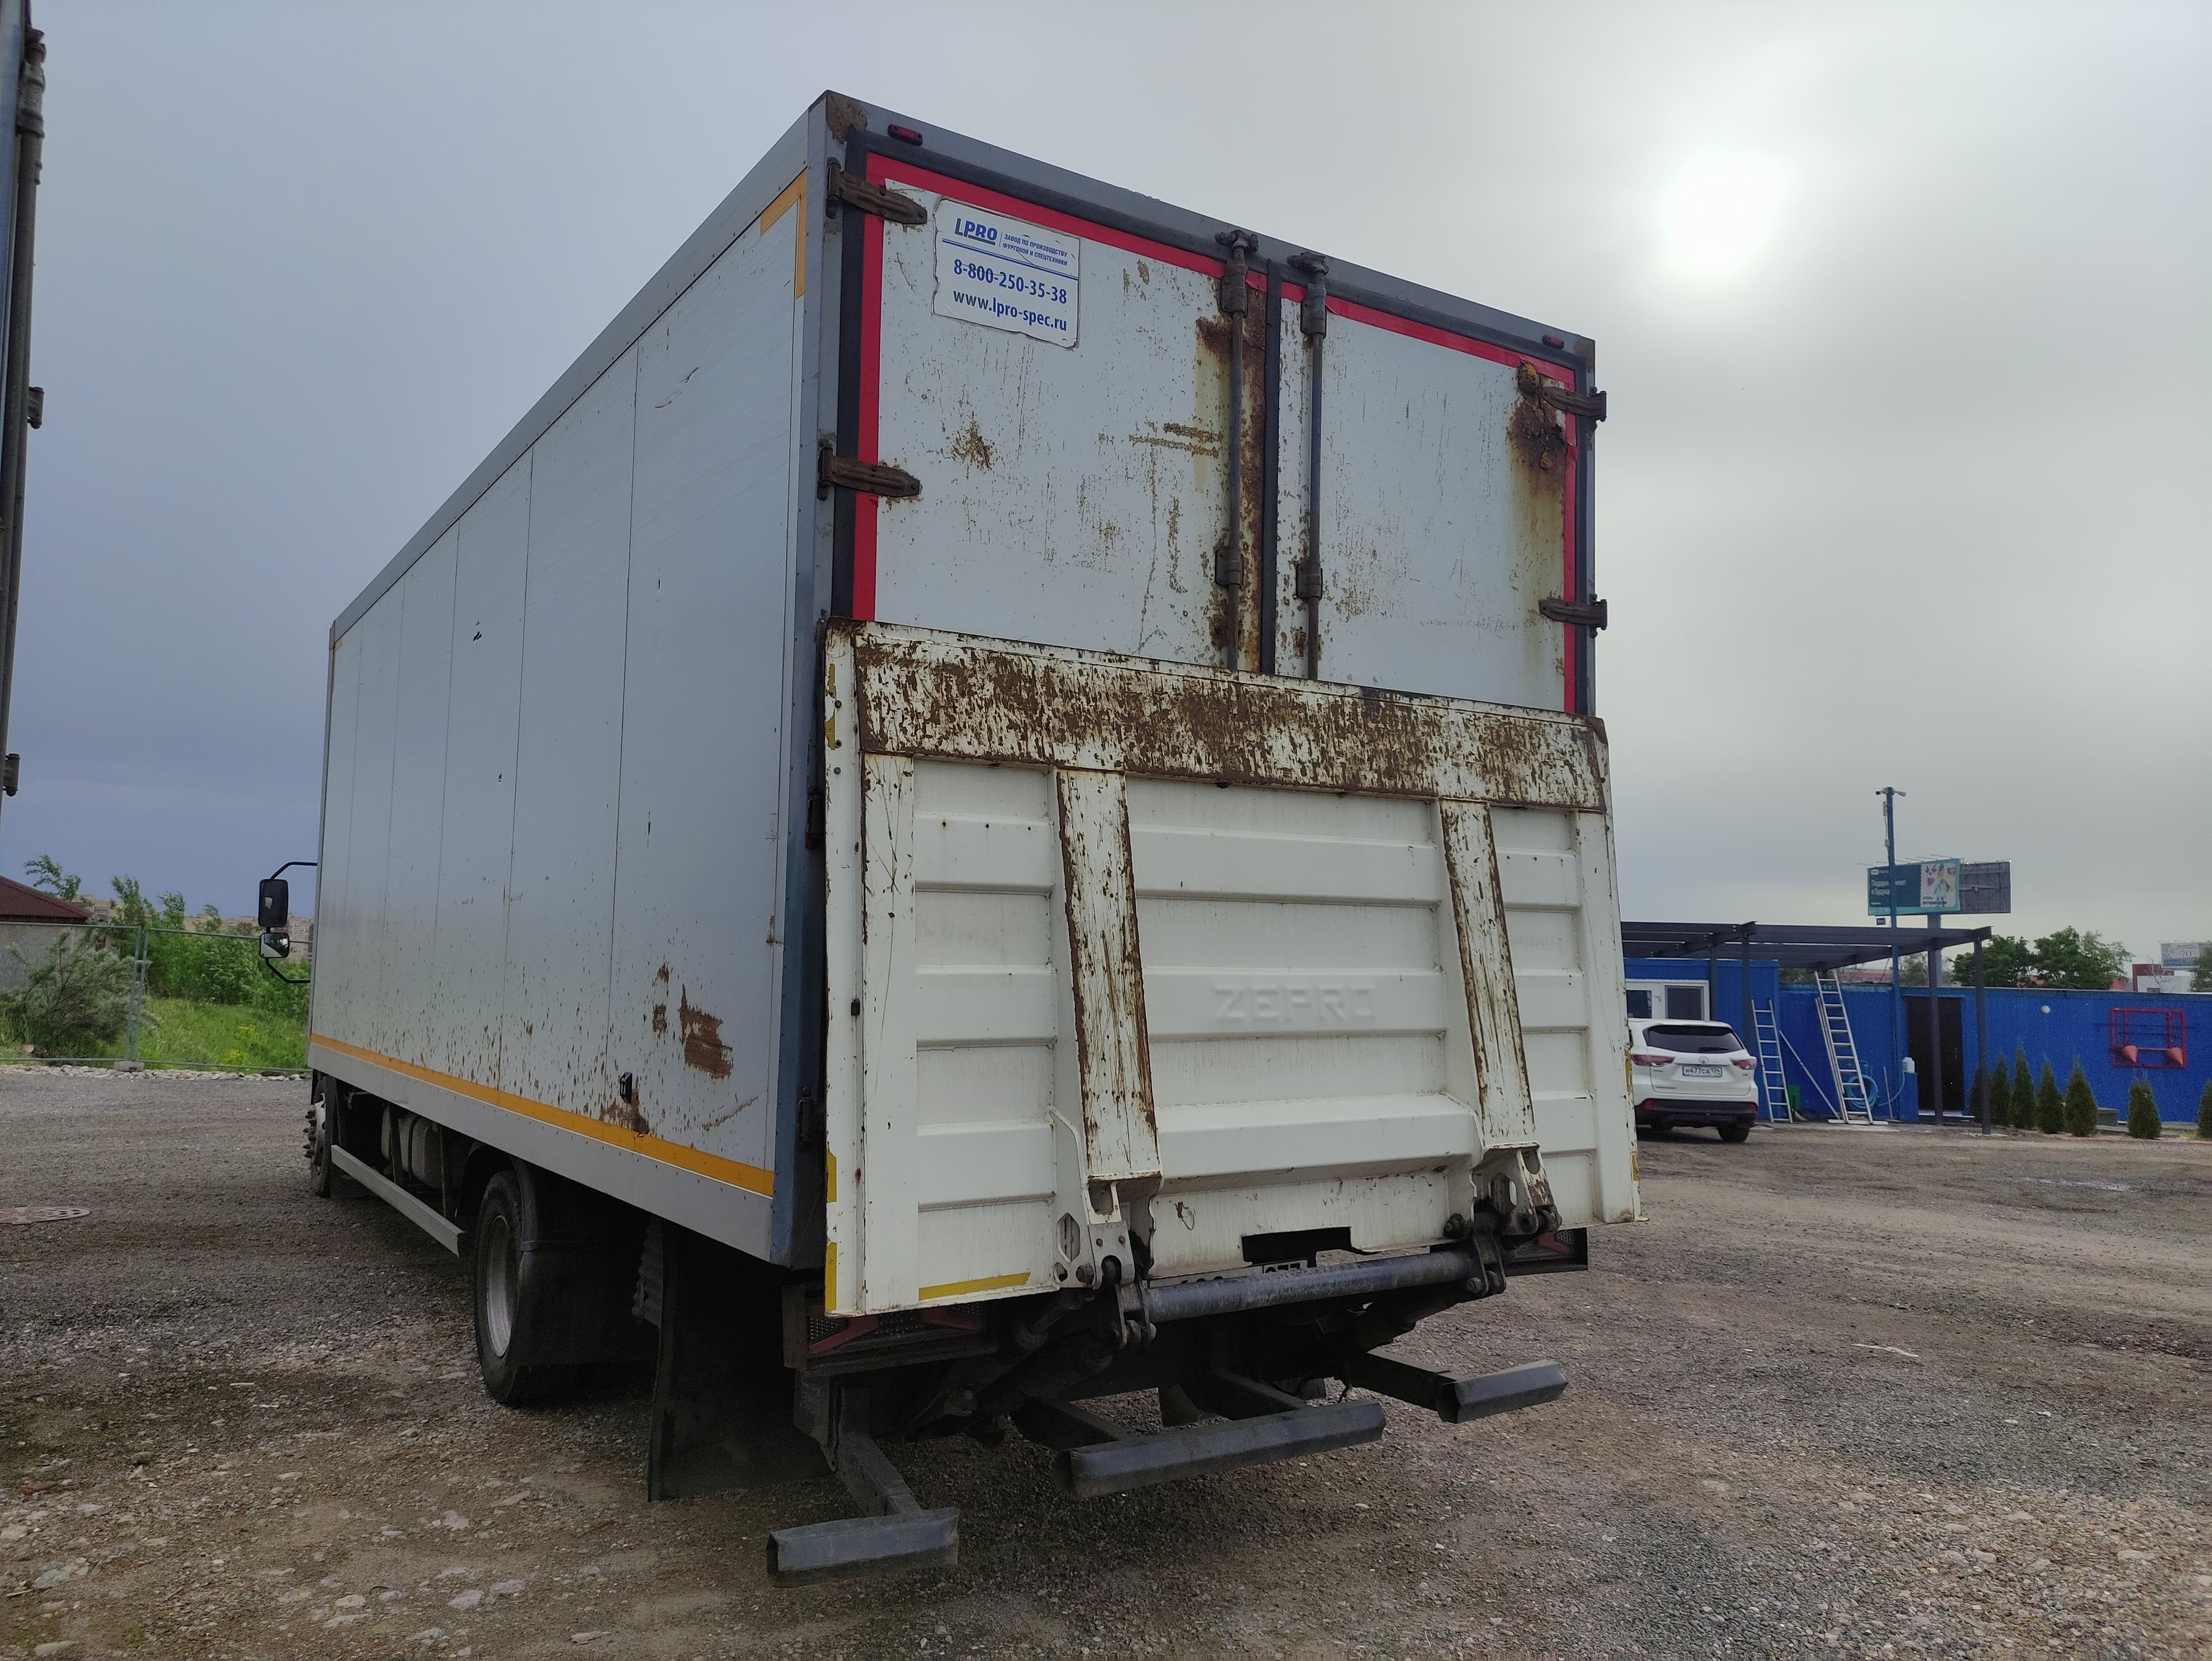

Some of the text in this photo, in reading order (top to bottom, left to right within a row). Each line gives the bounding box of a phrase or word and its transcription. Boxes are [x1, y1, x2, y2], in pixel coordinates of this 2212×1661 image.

[954, 218, 998, 241] LPRO
[1002, 243, 1029, 255] ФУРГОНОВ
[1034, 252, 1068, 266] СПЕЦТЕХНИКИ
[1004, 234, 1021, 244] ЗАВОД
[1029, 241, 1068, 258] ПРОИЗВОДСТВУ
[953, 259, 1067, 304] 8-800-250-35-38
[953, 290, 1067, 331] www.lpro-spec.ru
[1214, 984, 1376, 1023] ZEPRO
